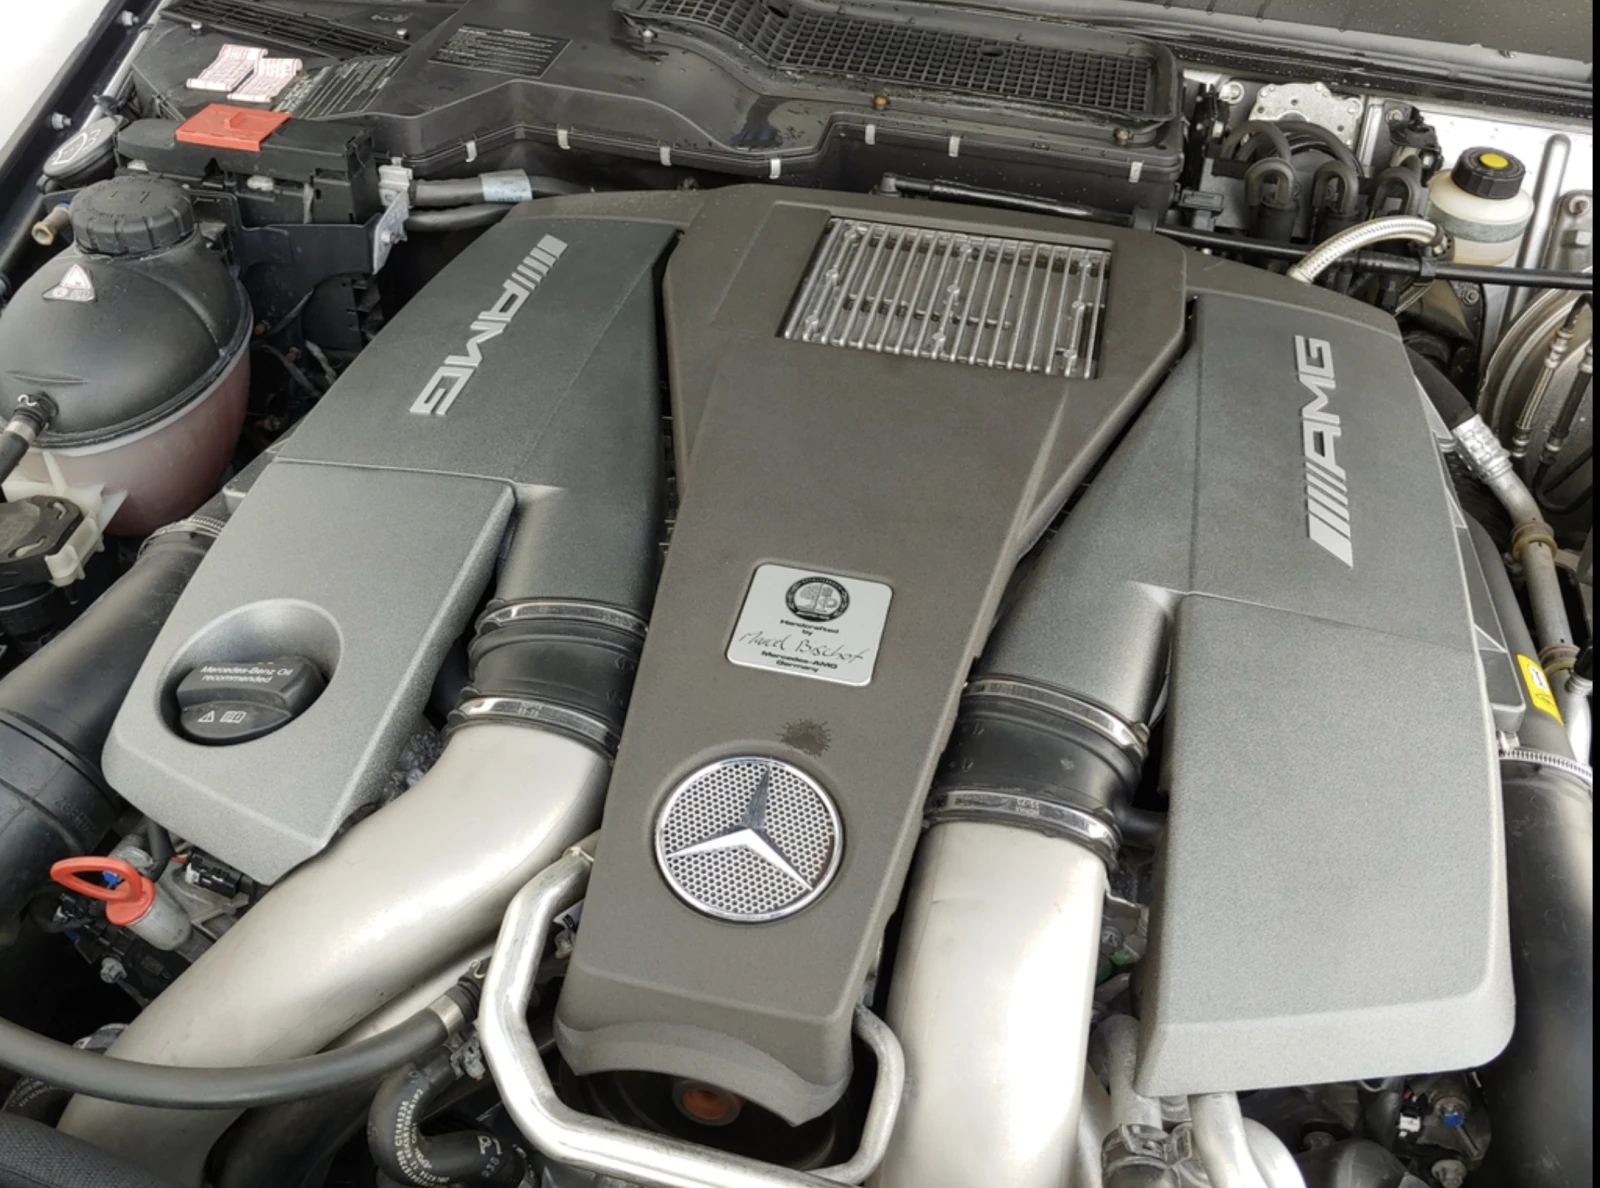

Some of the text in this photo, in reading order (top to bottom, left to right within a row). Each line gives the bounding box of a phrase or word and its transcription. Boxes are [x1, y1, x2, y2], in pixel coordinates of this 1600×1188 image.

[409, 279, 530, 416] AMG
[1295, 335, 1347, 482] AMG
[780, 619, 840, 634] Handcrafted
[761, 650, 838, 669] Mercedes-AMG
[776, 660, 819, 673] Germany
[200, 666, 294, 676] Mercedes-Benz Oil
[202, 675, 273, 684] recommended
